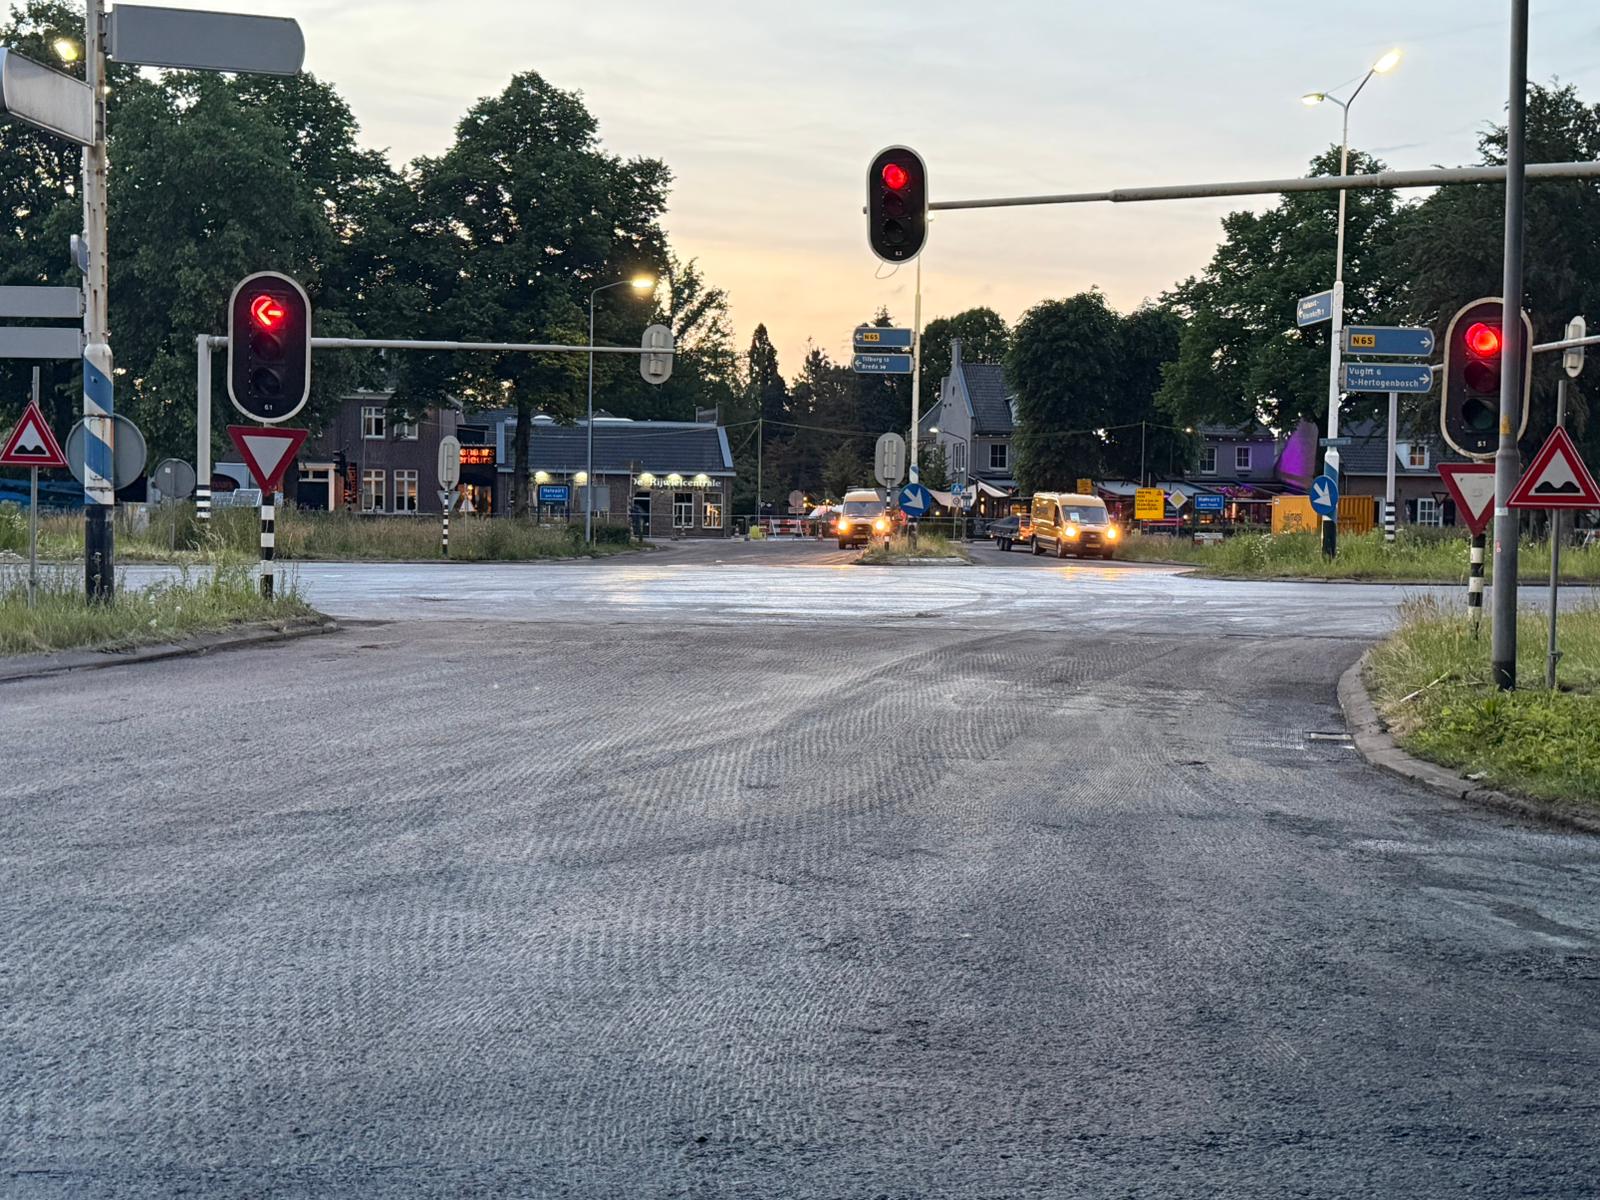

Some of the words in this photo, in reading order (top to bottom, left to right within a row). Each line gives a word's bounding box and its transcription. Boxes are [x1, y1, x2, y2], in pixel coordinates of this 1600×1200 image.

[1353, 336, 1373, 345] N65
[1349, 367, 1374, 378] Vught
[1348, 379, 1419, 388] 's-Hertogenbosch
[650, 478, 721, 488] Rijwielcentrale
